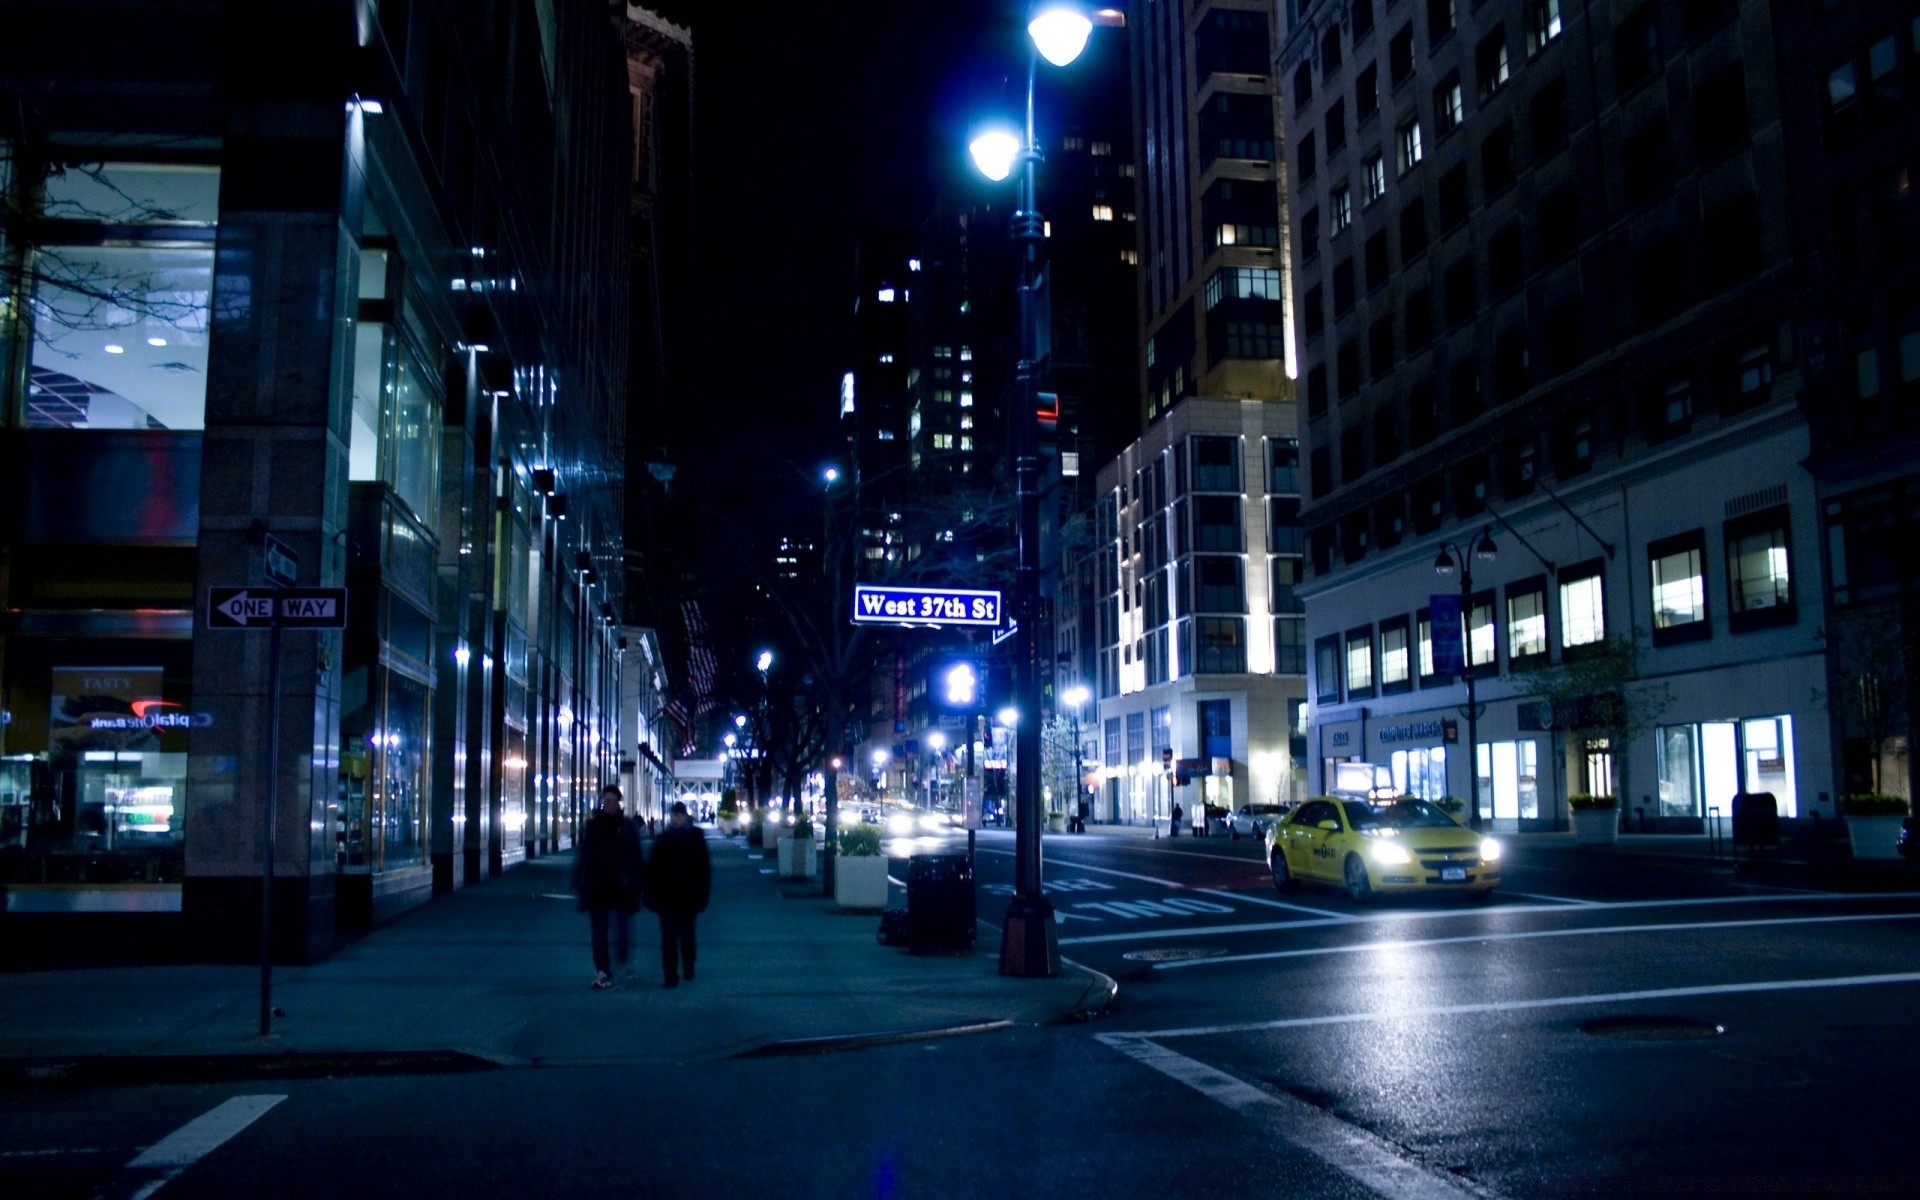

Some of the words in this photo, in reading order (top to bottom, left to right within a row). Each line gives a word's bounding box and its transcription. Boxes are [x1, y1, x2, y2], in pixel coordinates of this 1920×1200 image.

[230, 599, 269, 616] ONE
[287, 600, 327, 616] WAY
[861, 593, 916, 616] West
[920, 596, 966, 618] 37th
[971, 598, 995, 619] St
[82, 677, 132, 688] TASTY
